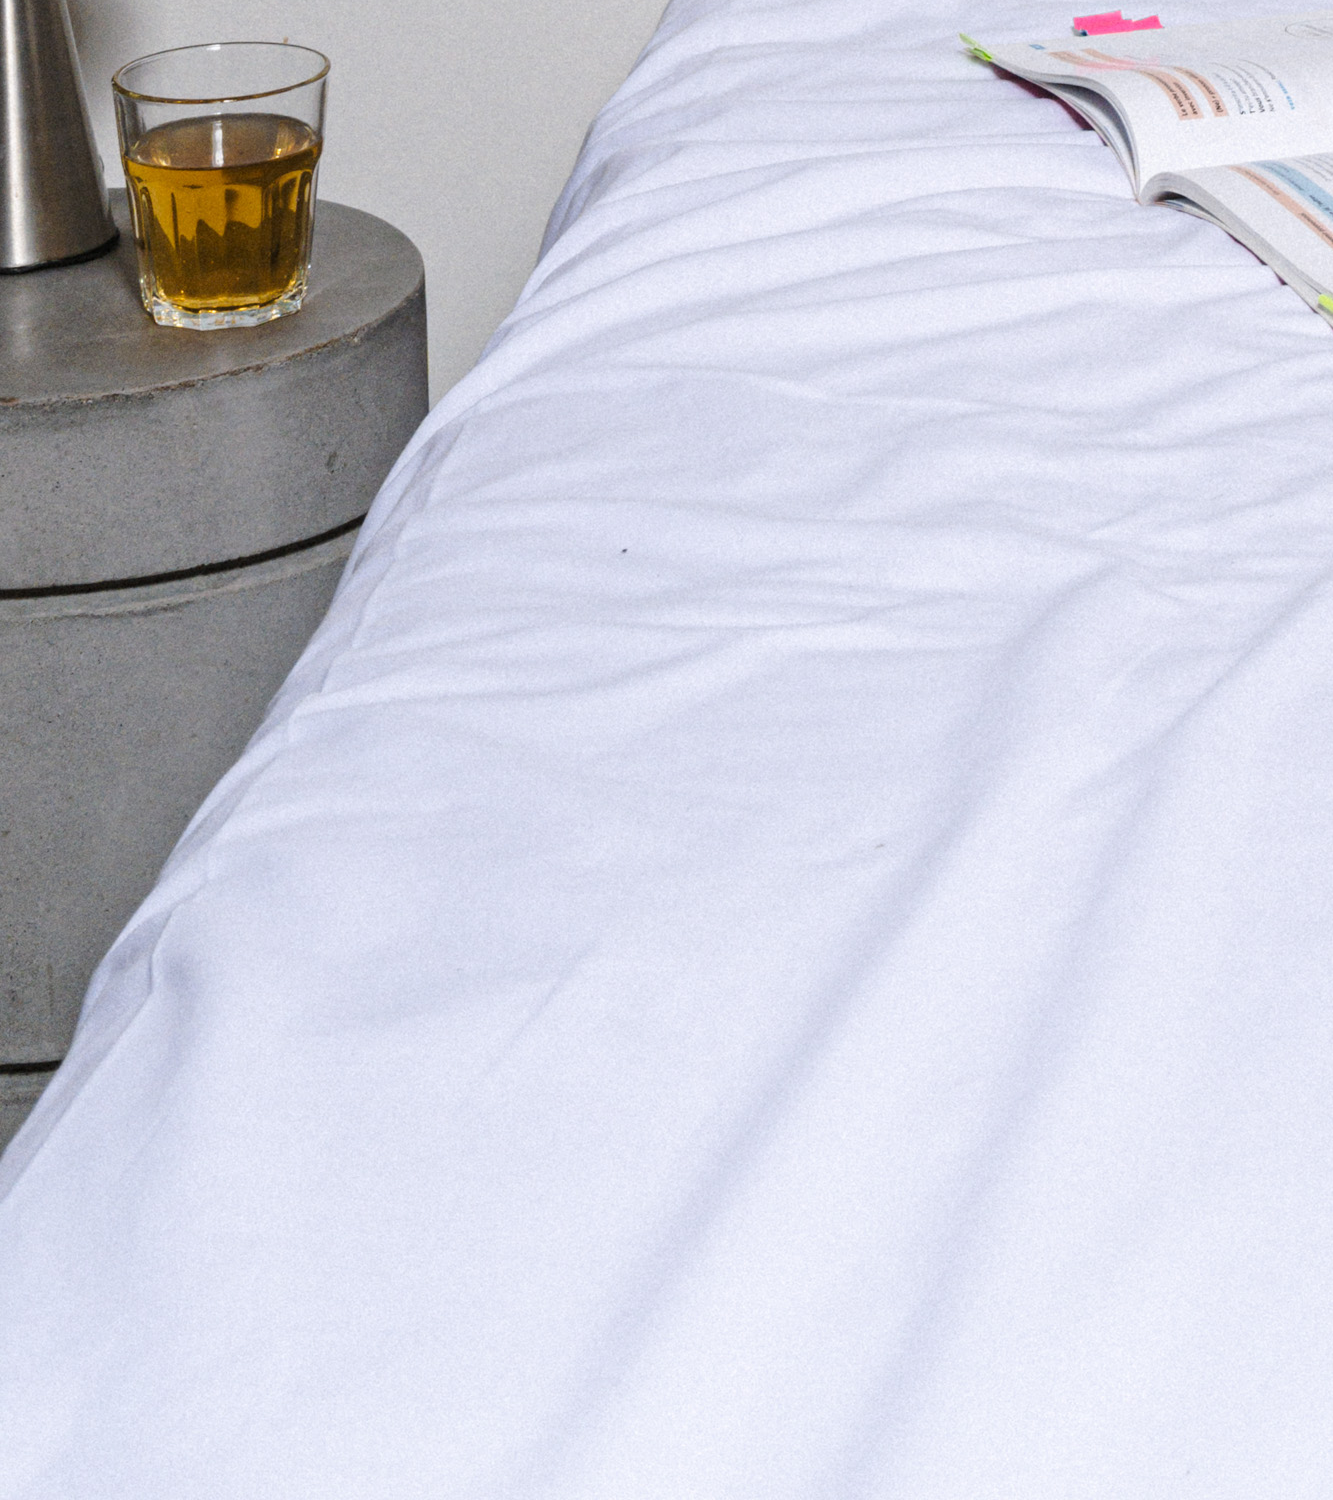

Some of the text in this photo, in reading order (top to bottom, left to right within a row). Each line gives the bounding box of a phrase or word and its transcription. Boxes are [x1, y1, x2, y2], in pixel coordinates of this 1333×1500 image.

[1170, 93, 1189, 116] Le verbe
[1186, 101, 1199, 114] avec
